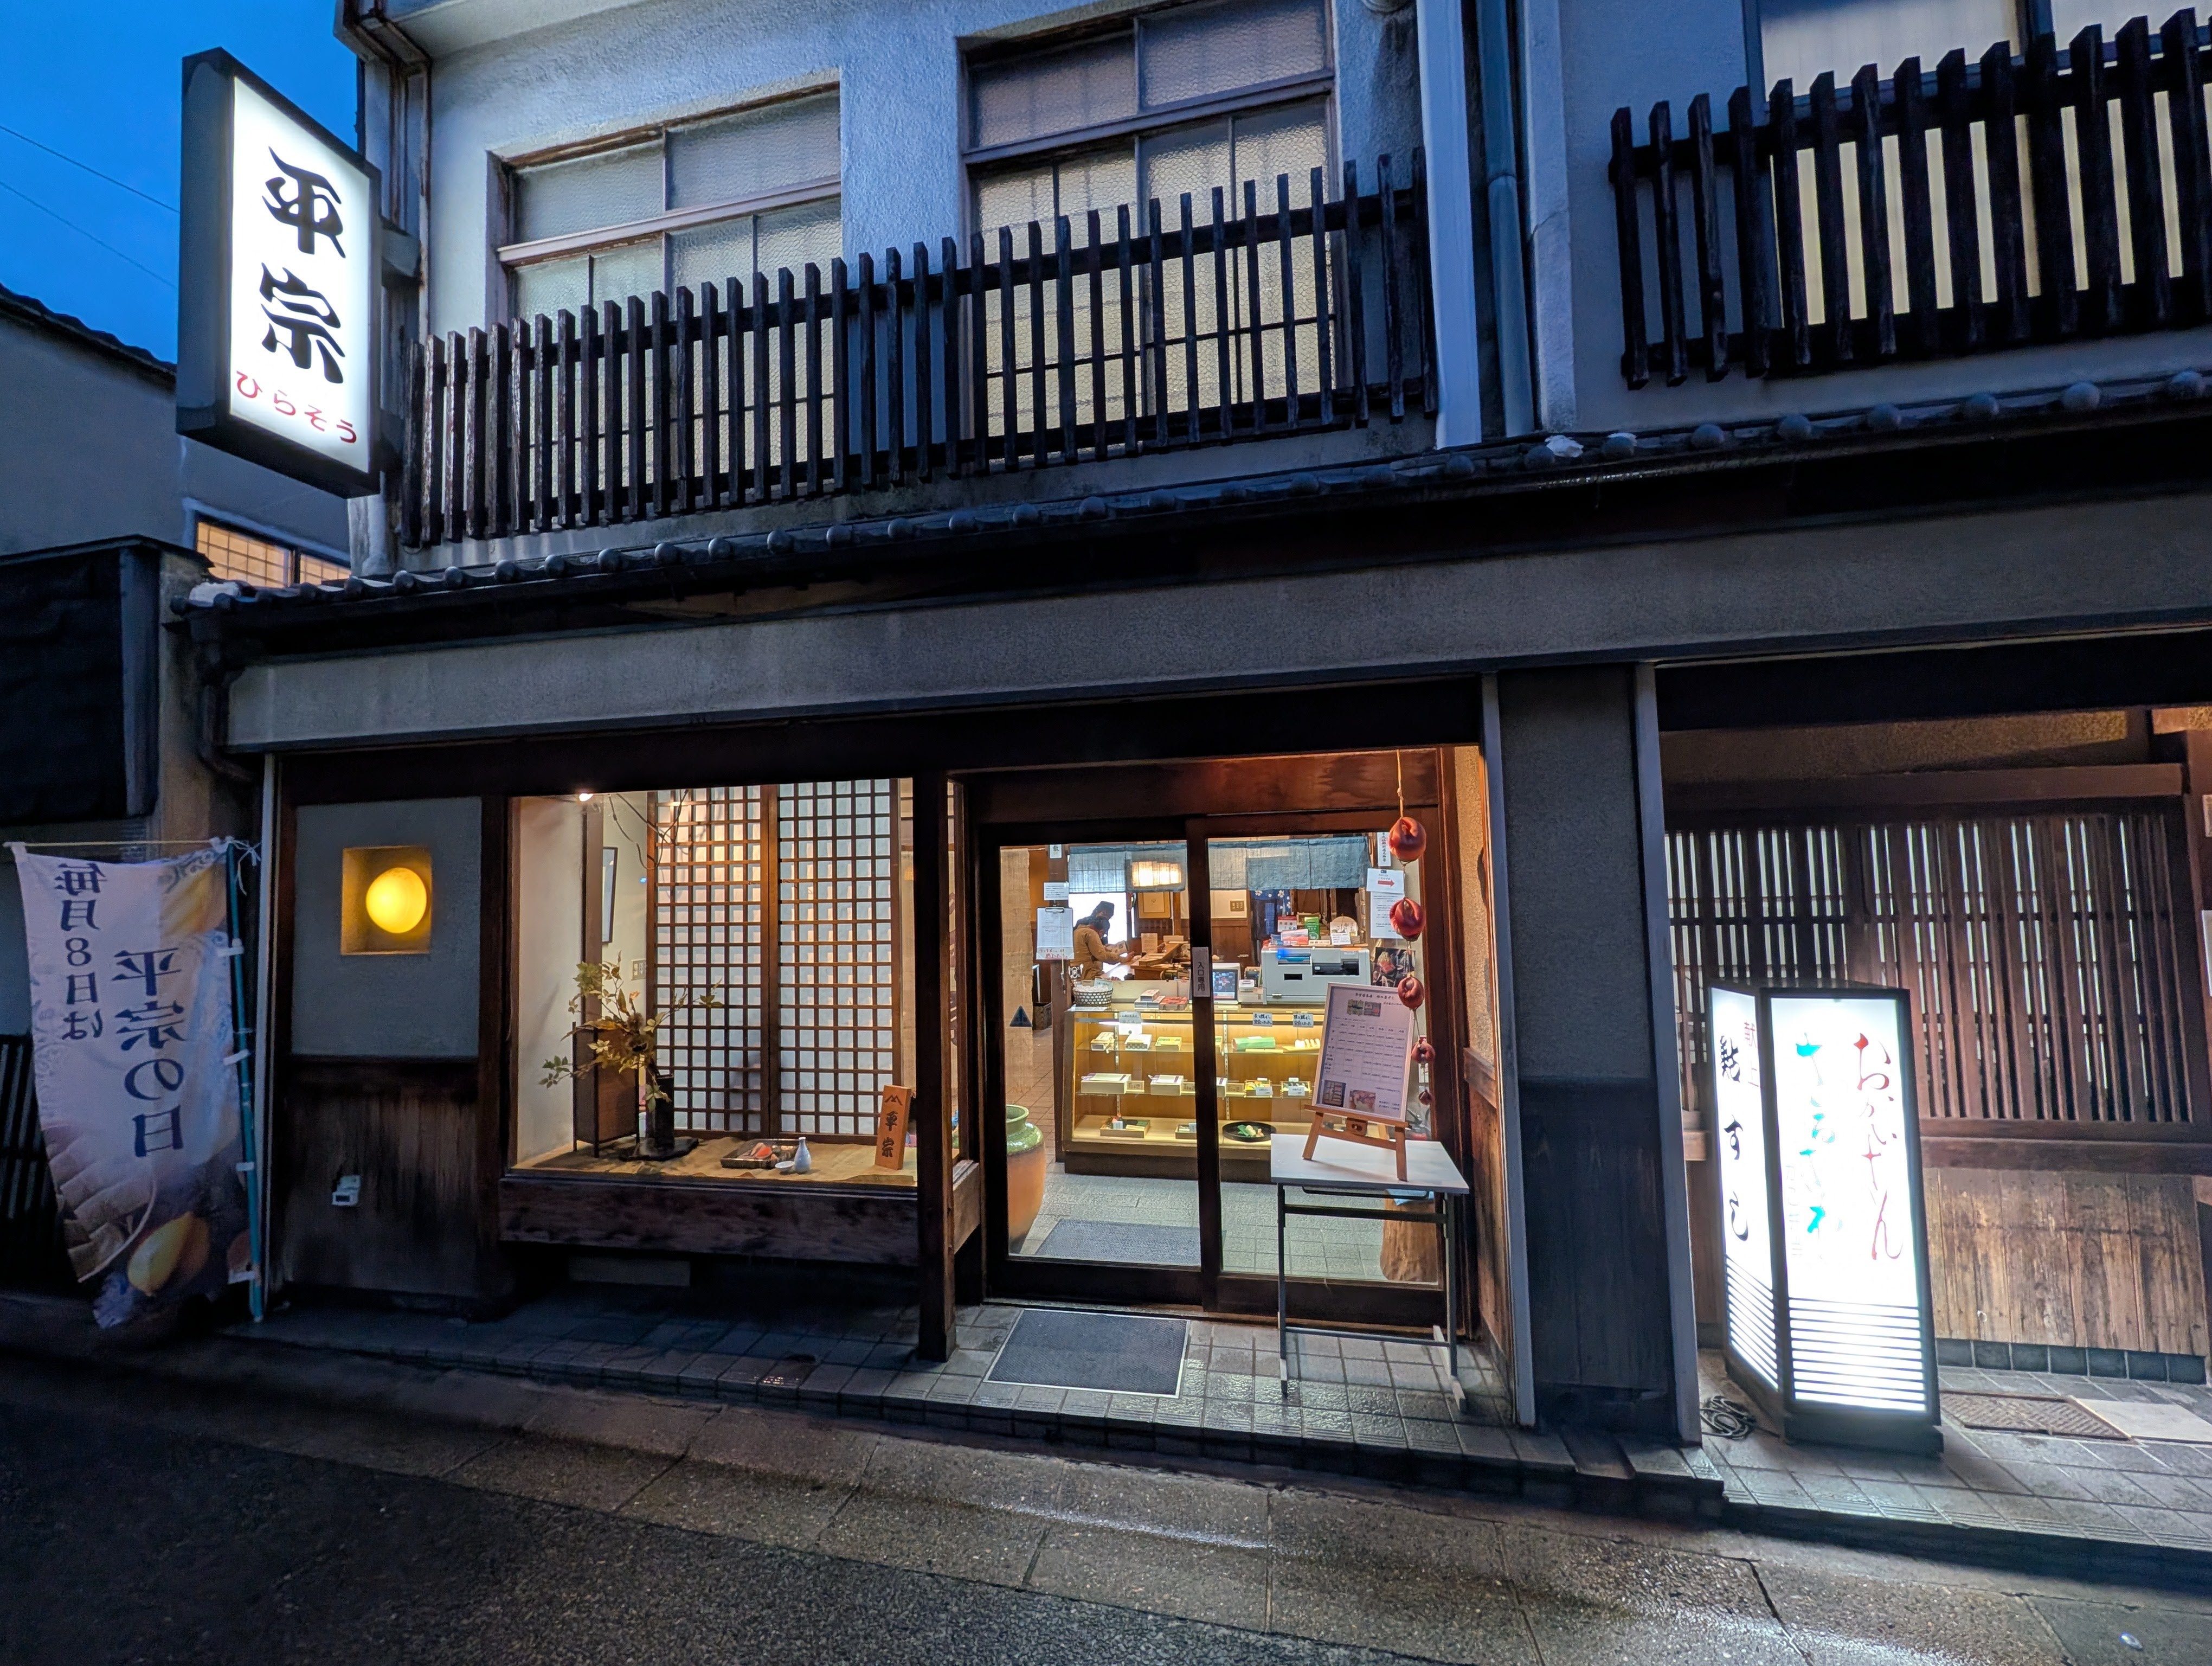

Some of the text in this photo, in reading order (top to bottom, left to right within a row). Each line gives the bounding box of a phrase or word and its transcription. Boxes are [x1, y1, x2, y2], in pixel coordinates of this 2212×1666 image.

[260, 145, 346, 385] 平宗
[236, 370, 357, 444] ひらそう
